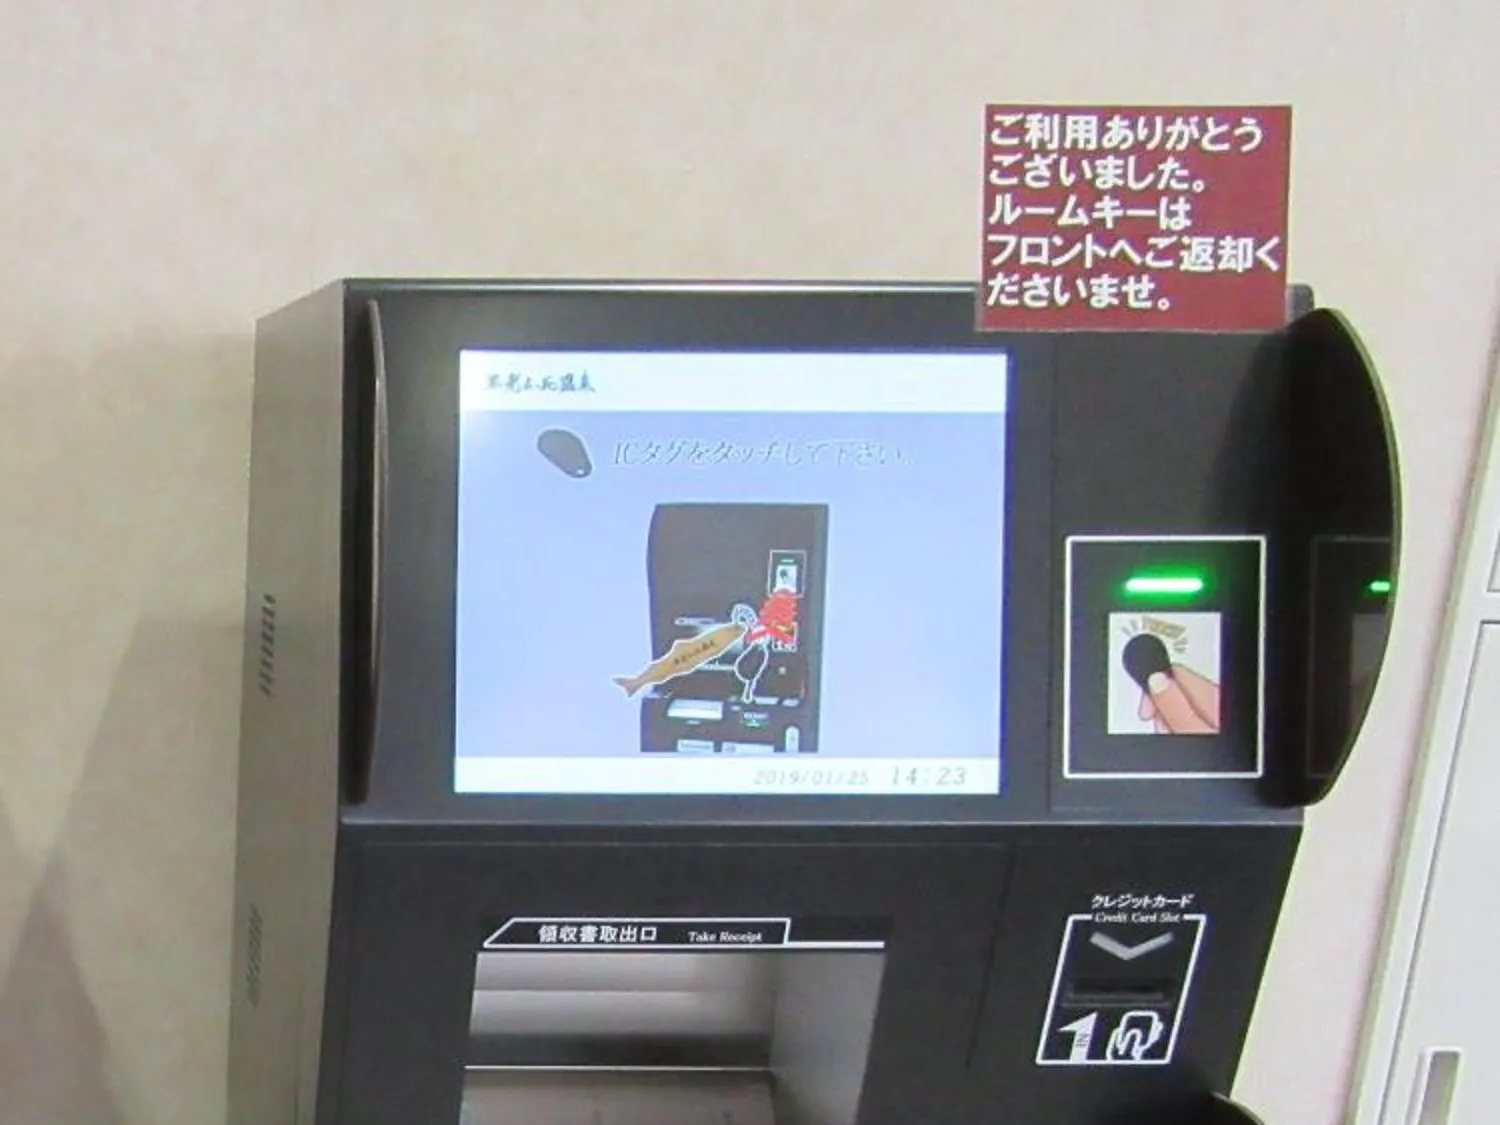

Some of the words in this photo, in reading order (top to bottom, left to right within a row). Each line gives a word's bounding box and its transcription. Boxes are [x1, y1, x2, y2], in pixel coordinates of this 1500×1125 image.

[990, 112, 1263, 152] ご利用ありがとう
[989, 152, 1205, 192] ございました。
[988, 193, 1192, 230] ルームキーは
[987, 233, 1281, 272] フロントへご返却く
[986, 272, 1171, 311] ださいませ。
[891, 765, 969, 786] 14:23
[1092, 893, 1195, 909] クレジットカード
[1094, 911, 1128, 923] Credit
[1130, 911, 1157, 923] Card
[538, 924, 658, 943] 領収書取出口
[687, 931, 716, 943] Take
[718, 931, 763, 944] Receipt
